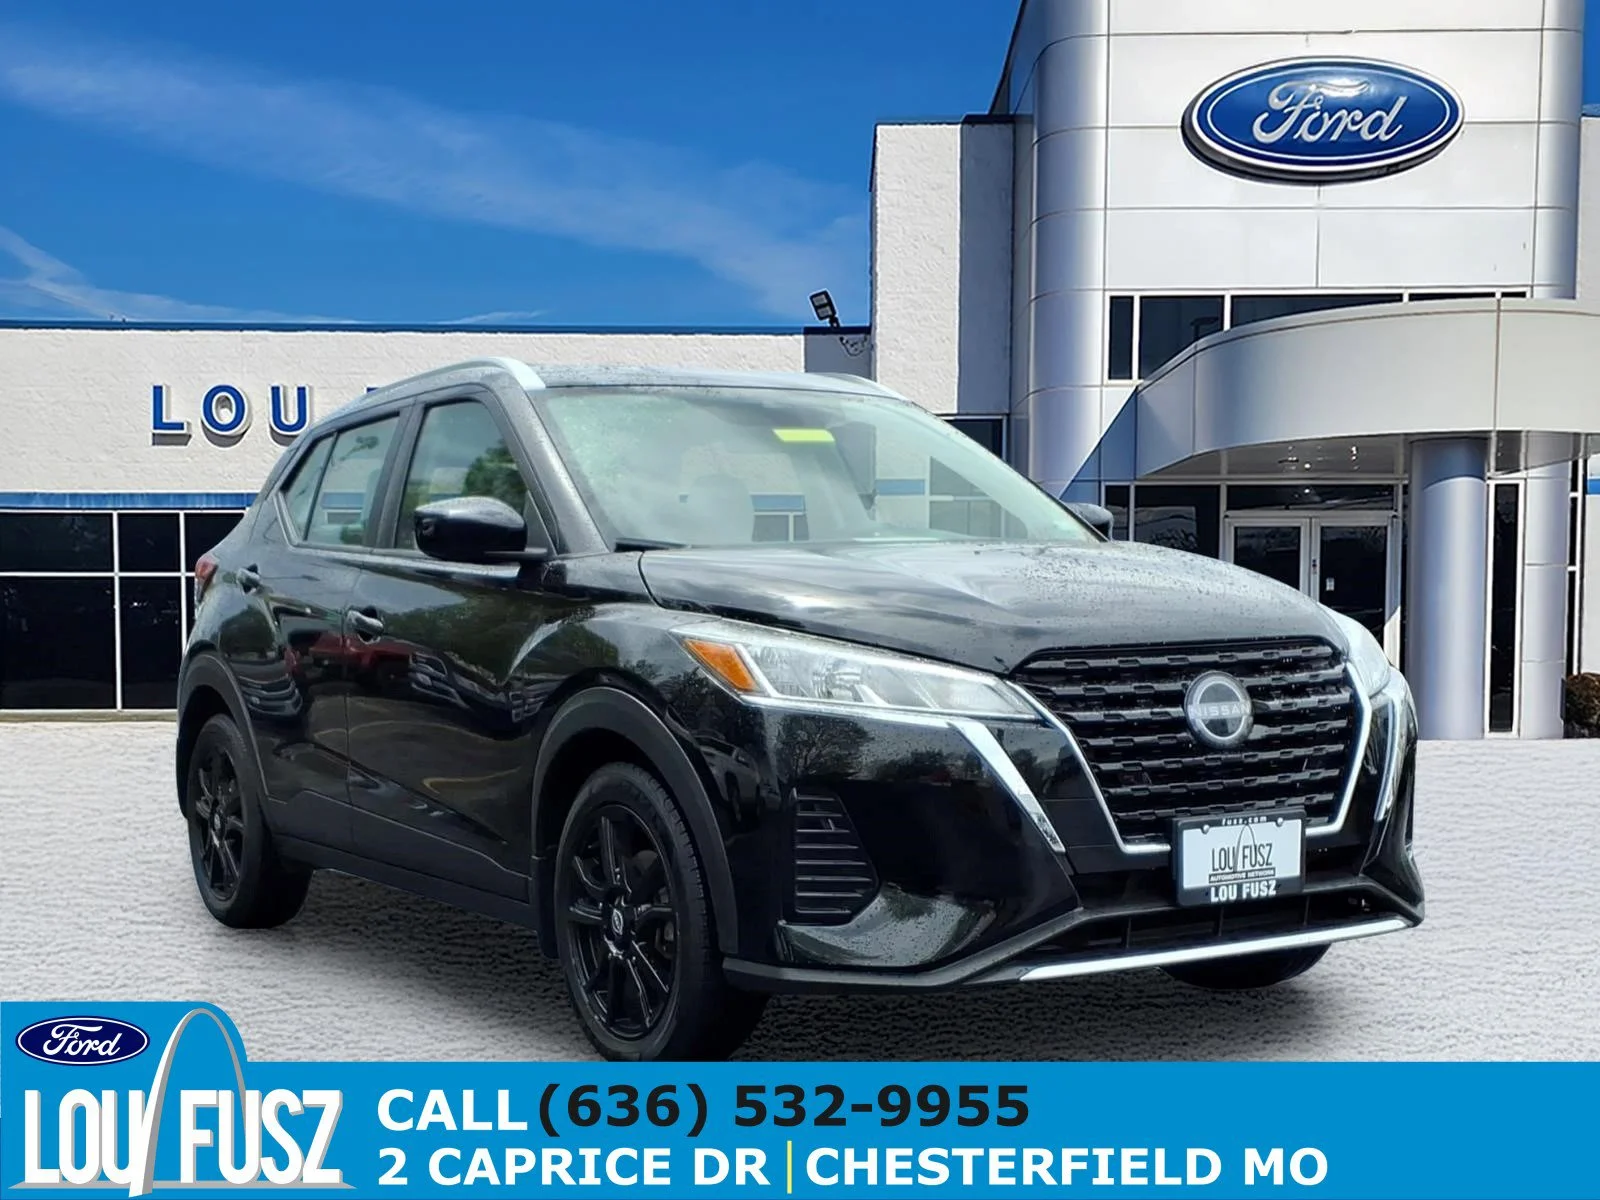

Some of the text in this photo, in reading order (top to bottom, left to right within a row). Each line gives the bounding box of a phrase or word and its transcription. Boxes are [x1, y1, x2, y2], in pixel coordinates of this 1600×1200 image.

[1253, 80, 1407, 144] Ford
[151, 384, 310, 435] LOU
[1189, 702, 1250, 719] NISSAN
[1211, 843, 1273, 872] LOU FUSZ
[1210, 880, 1276, 902] LOU FUSZ
